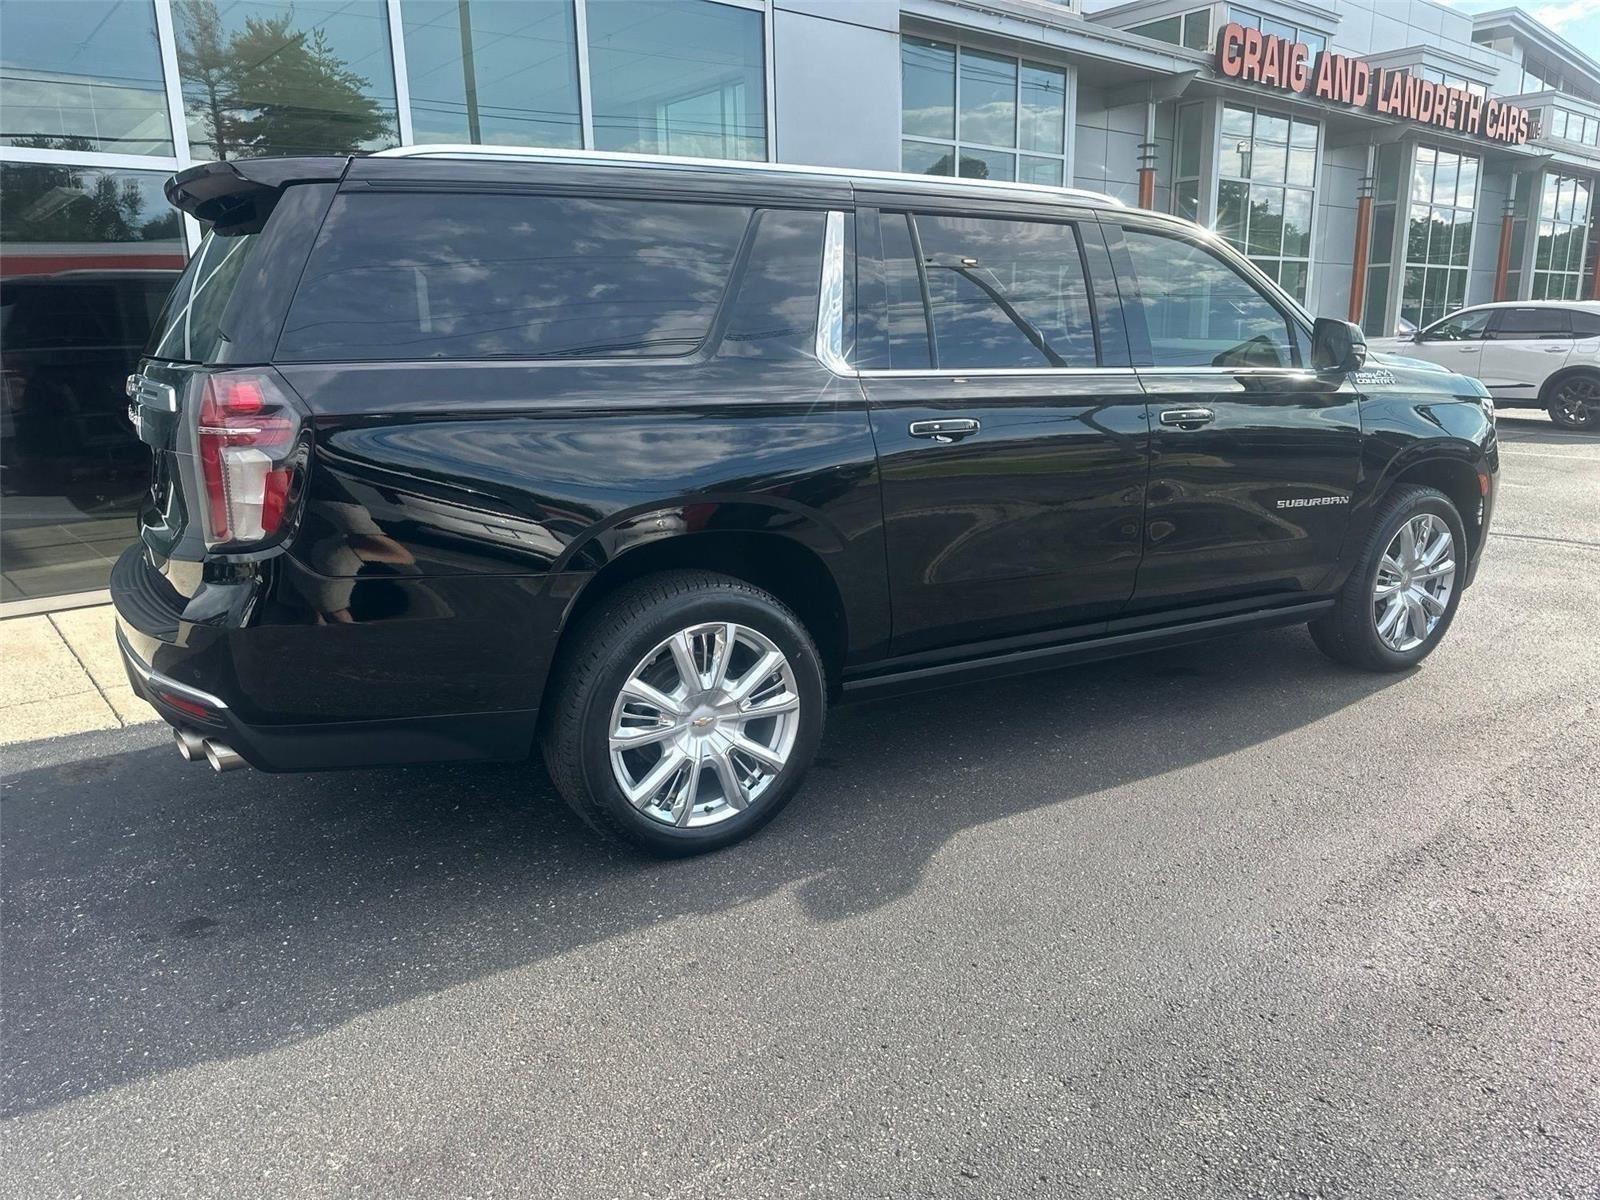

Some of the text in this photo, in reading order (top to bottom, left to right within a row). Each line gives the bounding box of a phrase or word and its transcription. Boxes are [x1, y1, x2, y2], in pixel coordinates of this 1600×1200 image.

[1220, 22, 1529, 145] CRAIG AND LANDRETH CARS
[1356, 377, 1397, 385] COUNTRY
[1276, 495, 1350, 509] SUBURBAN
